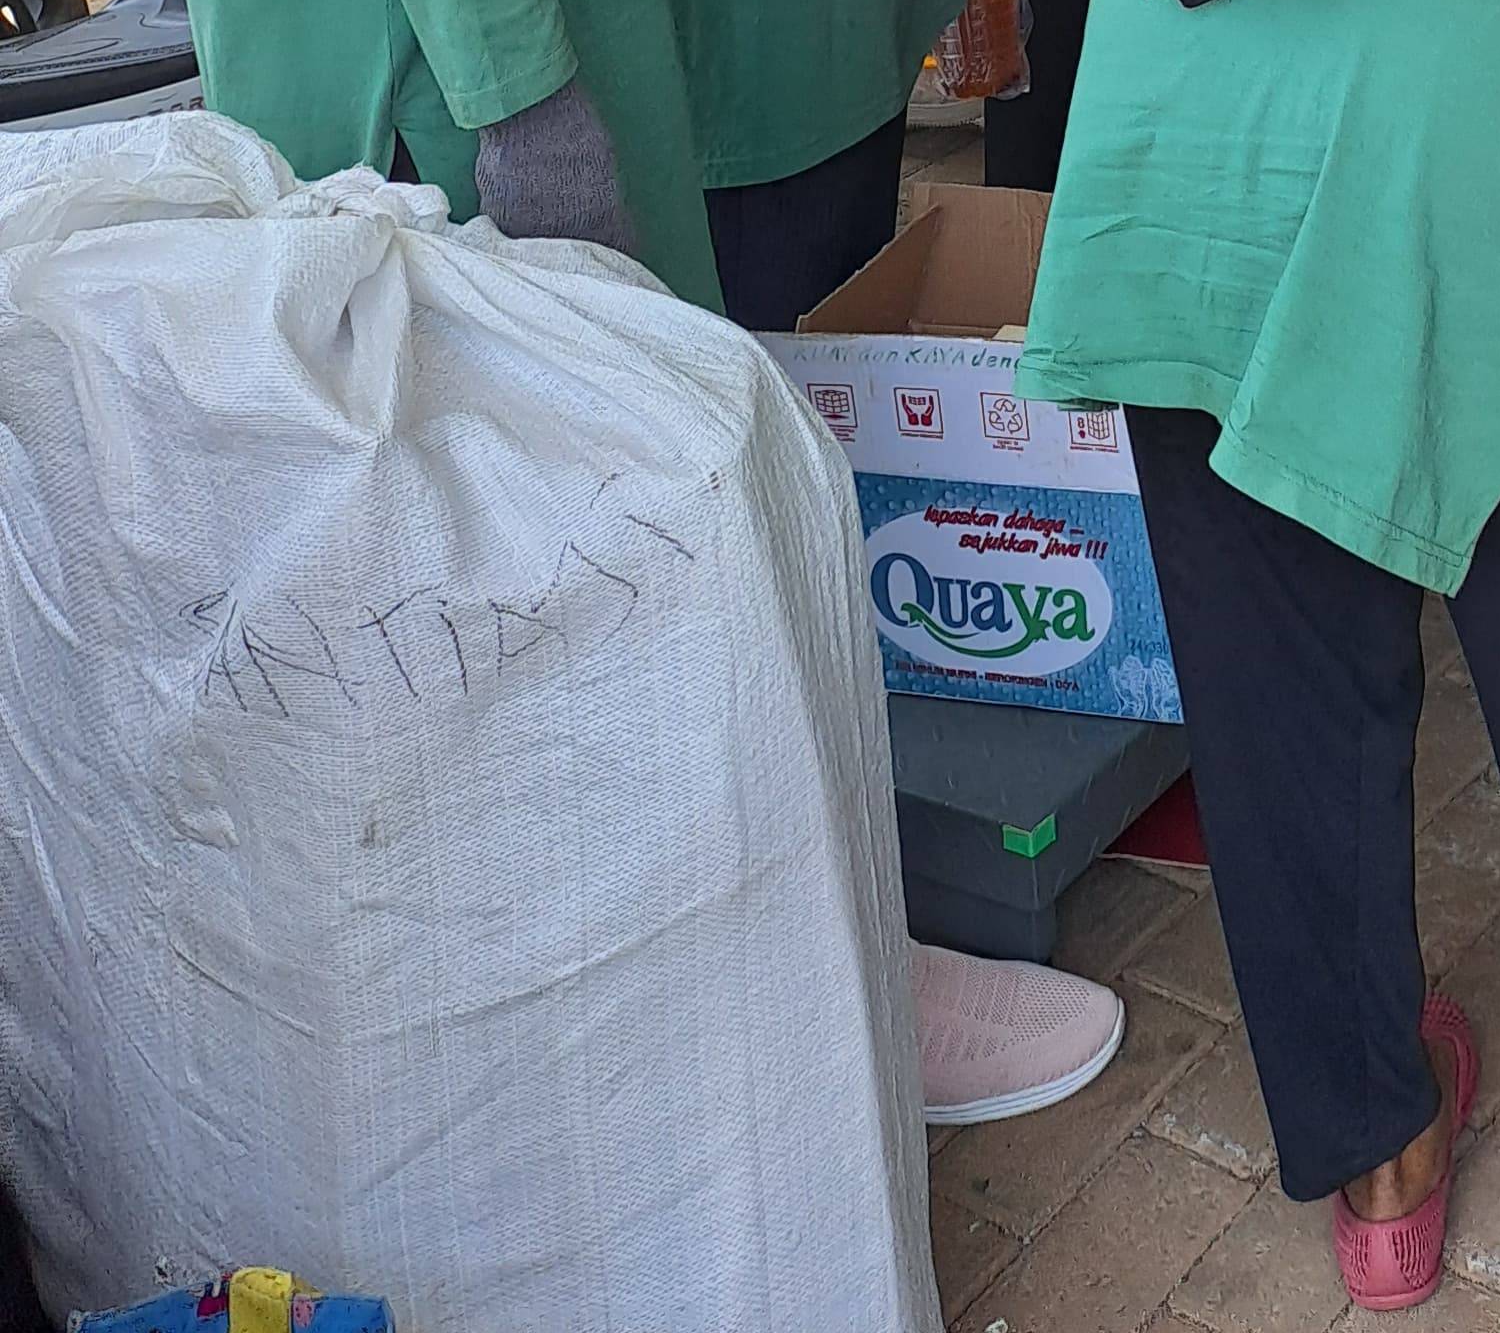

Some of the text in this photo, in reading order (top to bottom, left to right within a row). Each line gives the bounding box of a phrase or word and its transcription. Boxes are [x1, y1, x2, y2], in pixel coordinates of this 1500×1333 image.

[1003, 507, 1065, 536] dahaga
[1040, 537, 1080, 560] jiwa
[870, 552, 1096, 658] Quaya
